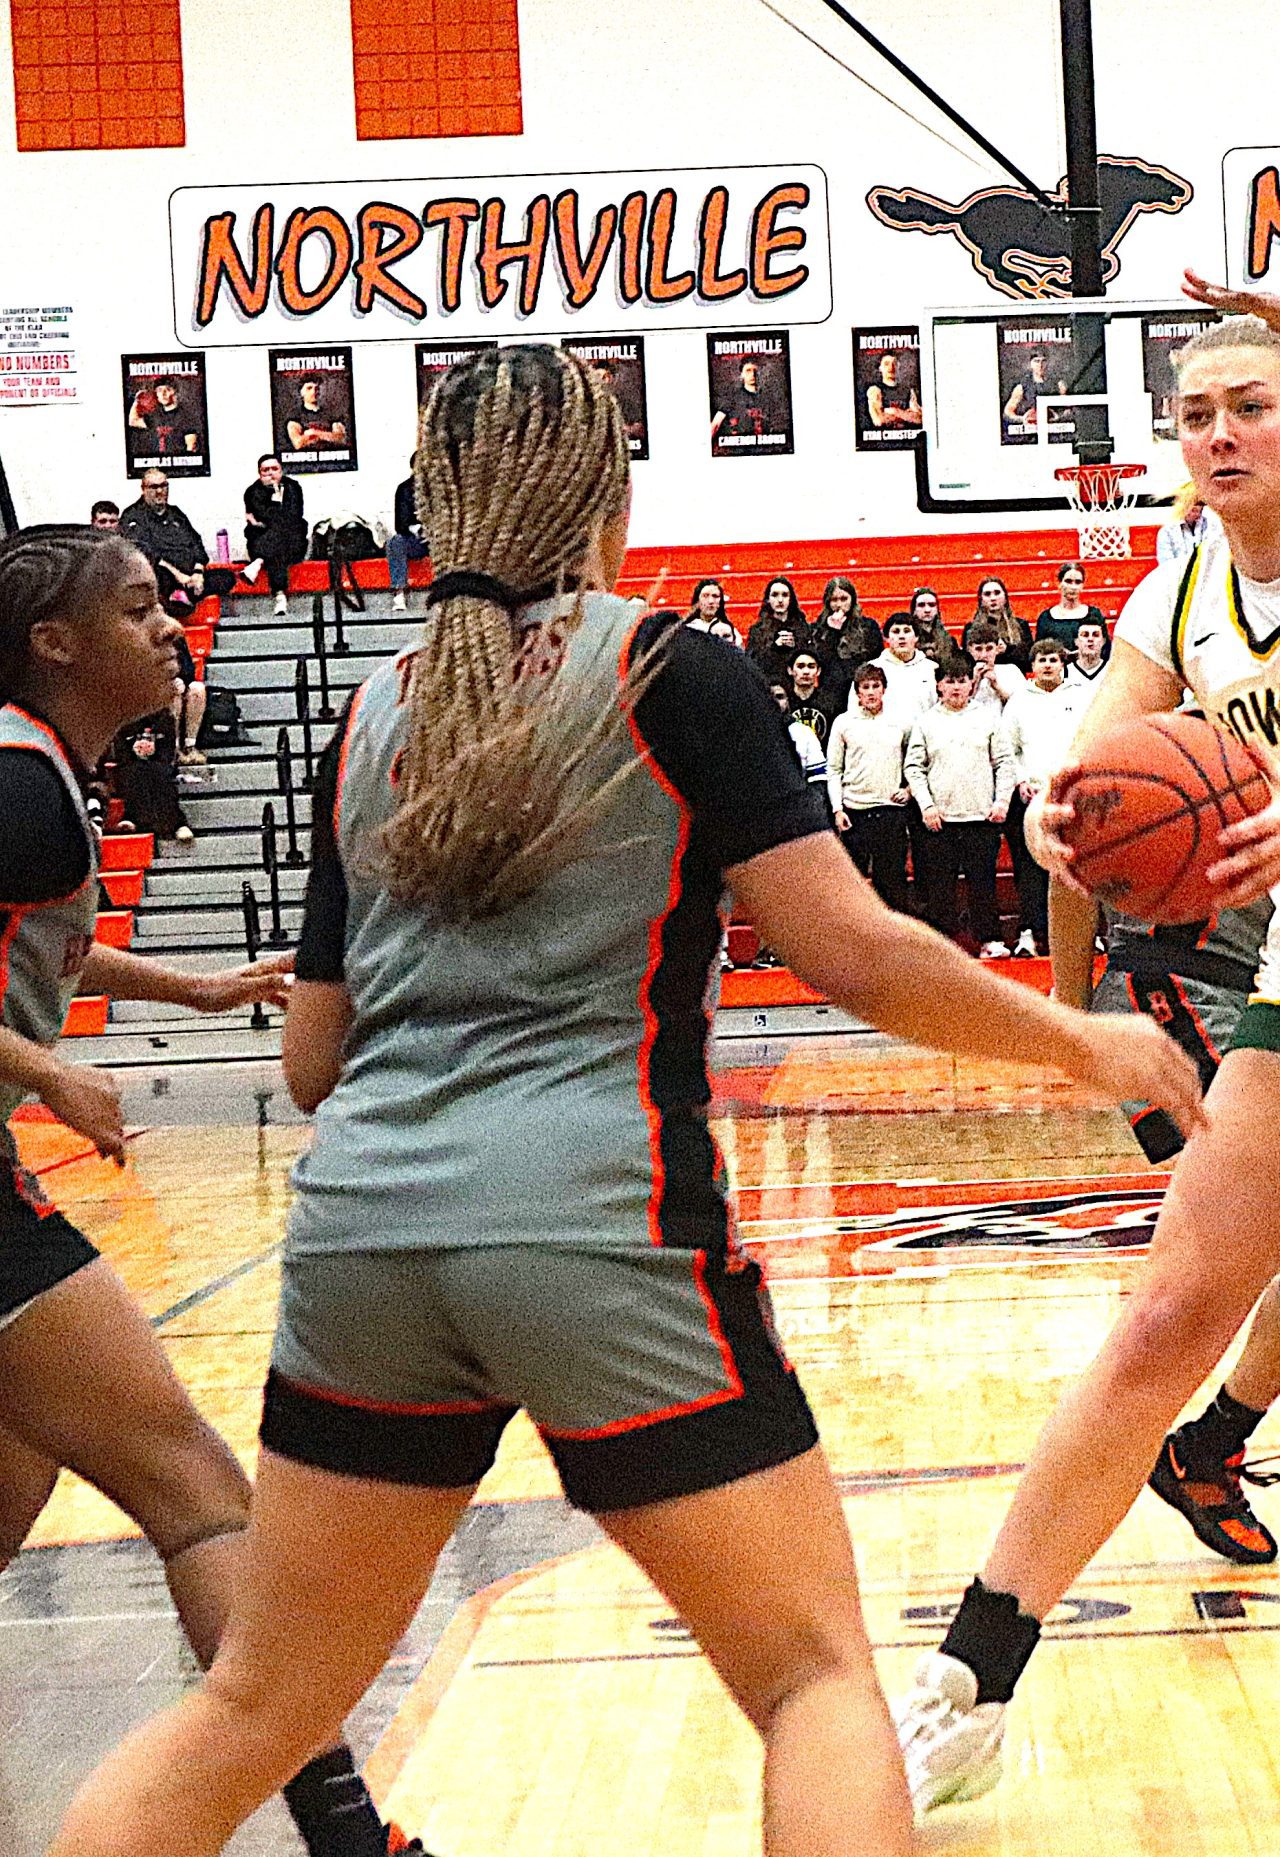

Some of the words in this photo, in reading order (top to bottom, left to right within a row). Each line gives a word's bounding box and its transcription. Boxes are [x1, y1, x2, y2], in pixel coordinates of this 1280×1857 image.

[196, 183, 809, 328] NORTHVILLE
[1004, 327, 1072, 344] NORTHVILLE
[714, 338, 783, 355] NORTHVILLE
[129, 361, 198, 377] NORTHVILLE
[276, 355, 345, 372] NORTHVILLE
